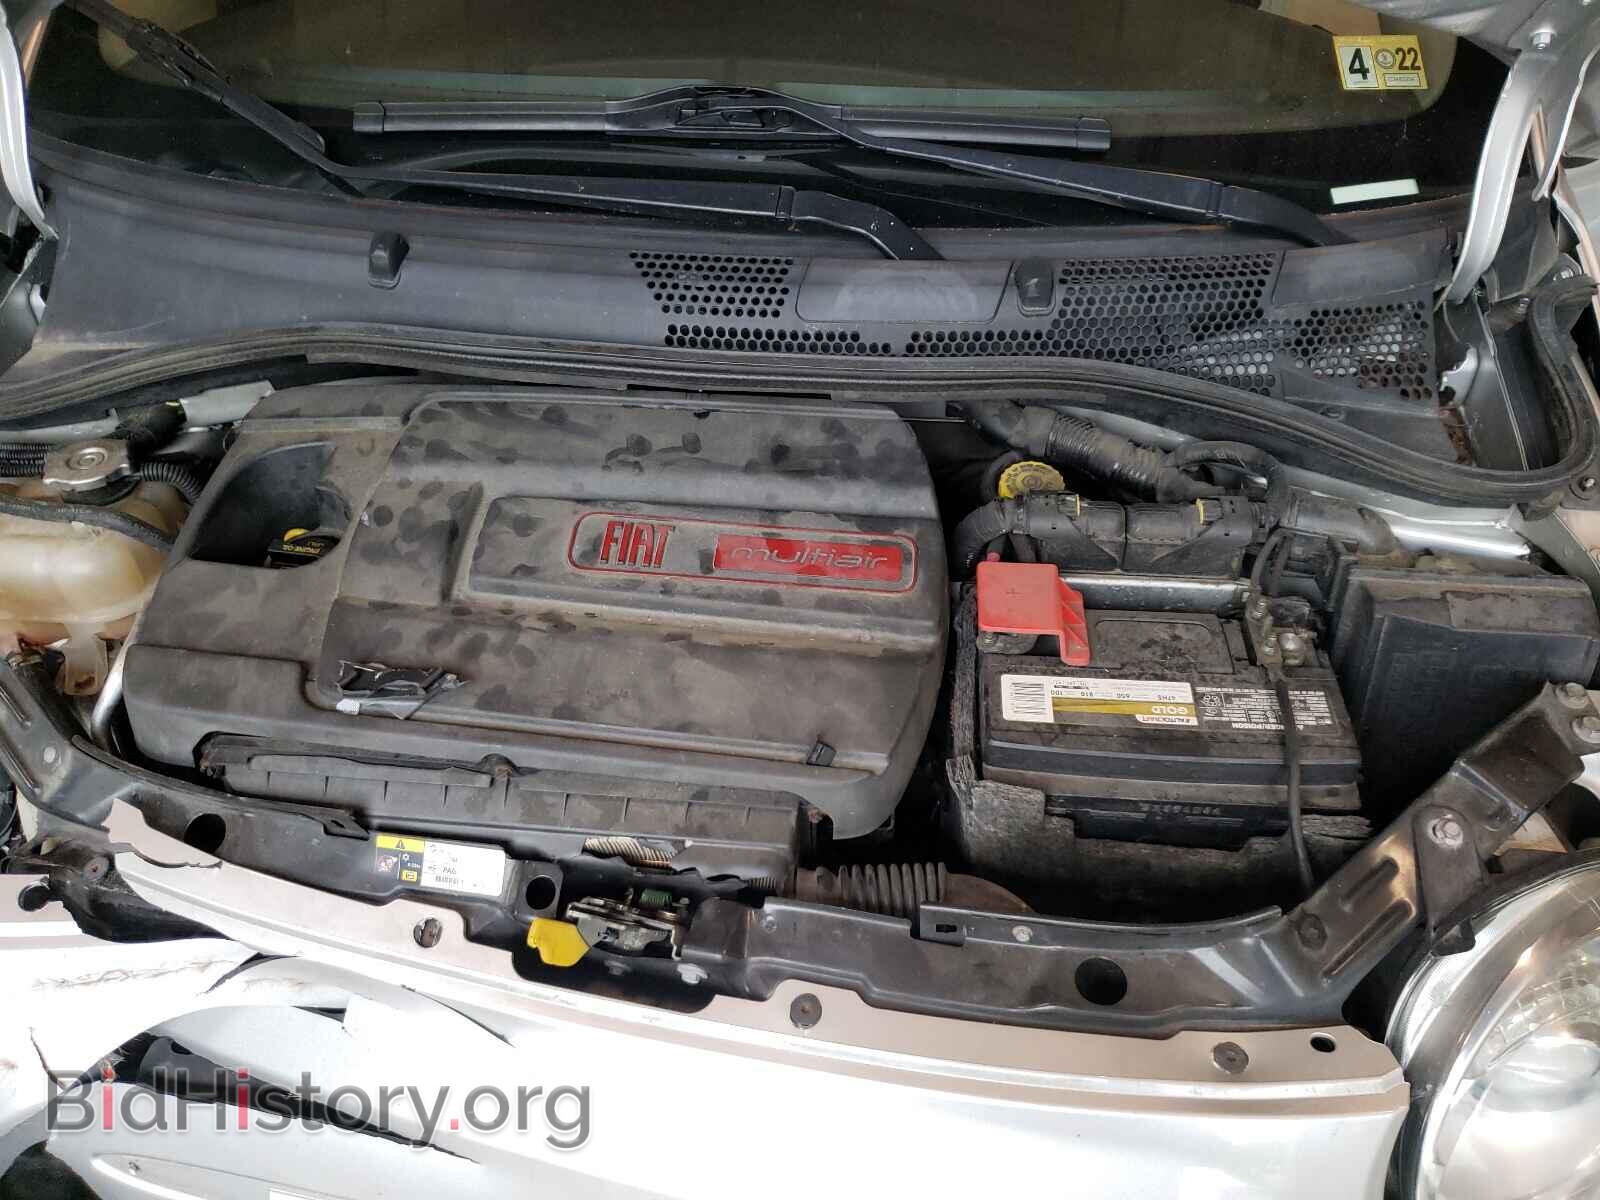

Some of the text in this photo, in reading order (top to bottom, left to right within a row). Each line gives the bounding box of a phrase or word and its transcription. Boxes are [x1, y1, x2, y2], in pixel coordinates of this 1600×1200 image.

[1349, 47, 1422, 80] 4 22
[601, 520, 675, 568] FIAT
[729, 545, 888, 568] multiair
[1152, 706, 1188, 714] GOLD
